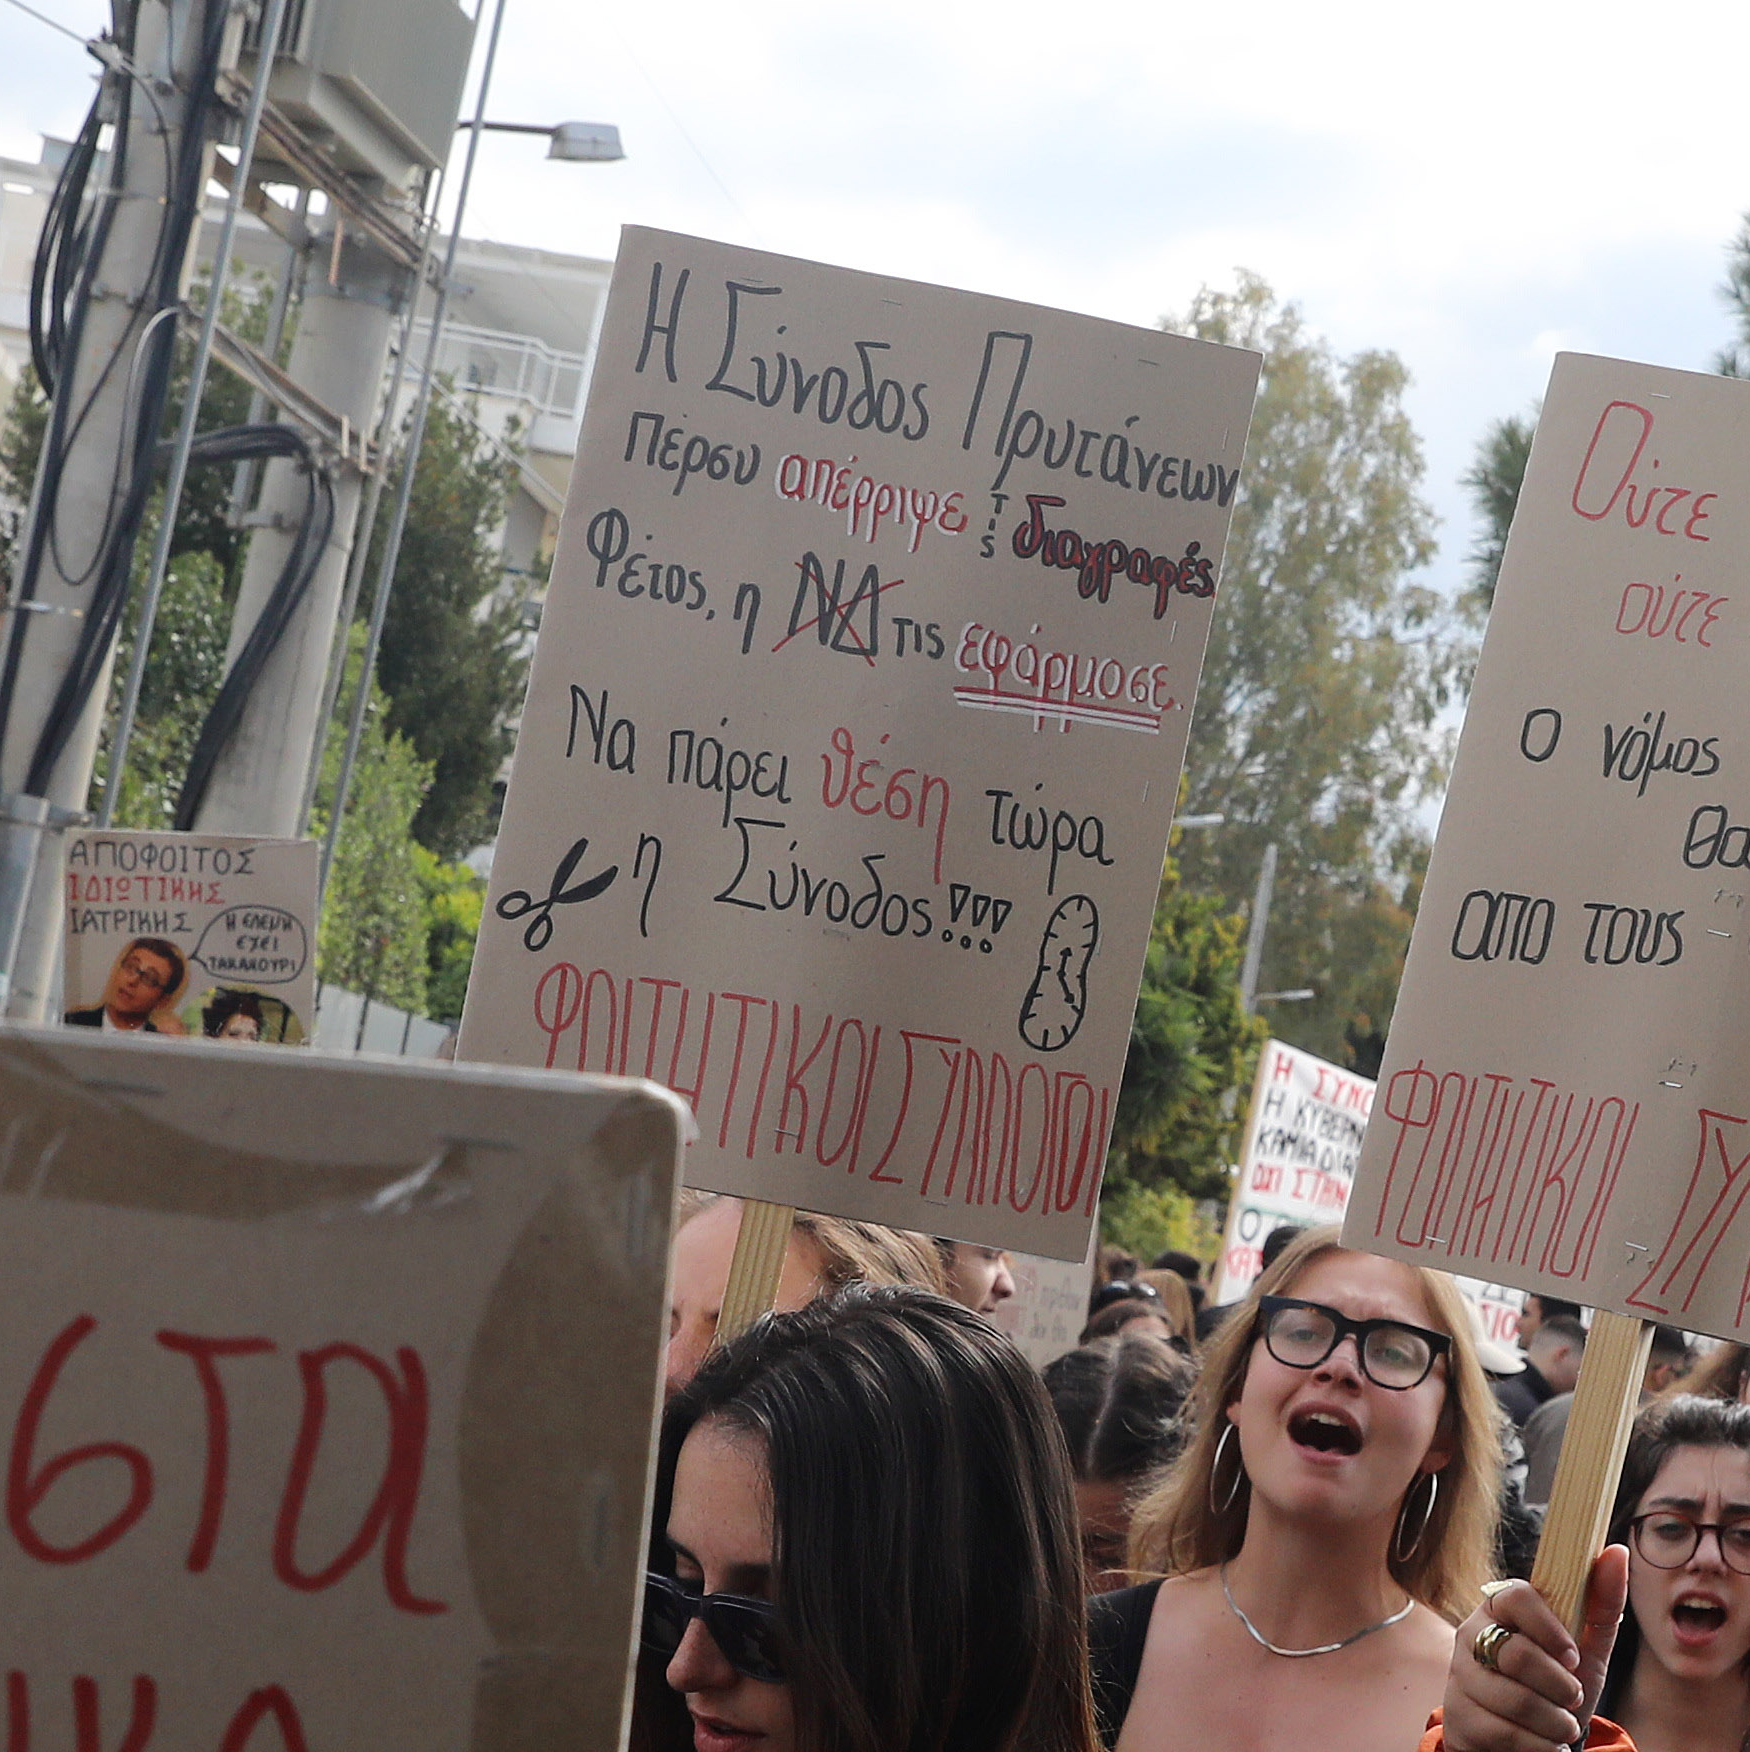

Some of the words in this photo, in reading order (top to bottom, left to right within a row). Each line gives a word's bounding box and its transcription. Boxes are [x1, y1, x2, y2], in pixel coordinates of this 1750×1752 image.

[635, 262, 690, 382] Η
[706, 281, 929, 440] Σύνοδος
[962, 331, 1240, 507] Πρυτάνεων
[624, 411, 761, 496] Πέρσυ
[775, 454, 968, 553] απέρριψε
[1012, 494, 1216, 619] διαγραφές
[1572, 400, 1717, 542] Ούτε
[587, 508, 715, 621] Φέτος,
[733, 583, 761, 655] η
[1615, 574, 1728, 647] ούτε
[565, 684, 635, 773] Να
[667, 718, 791, 826] πάρει
[821, 726, 950, 884] θέση
[986, 782, 1114, 895] τώρα
[1603, 710, 1720, 798] νόμος
[67, 873, 226, 905] ΙΔΙΩΤΙΚΗΣ
[69, 839, 256, 875] ΑΠΟΦΟΙΤΟΣ
[633, 833, 661, 937] η
[70, 907, 192, 933] ΙΑΤΡΙΚΗΣ
[1584, 903, 1685, 965] τους
[535, 961, 883, 1174] ΦΟΙΤΗΤΙΚΟΙ
[869, 1030, 1108, 1218] ΣΥΛΛΟΓΟΙ
[1264, 1088, 1285, 1117] Η
[1294, 1096, 1366, 1147] ΚΥΒΕΡΝ
[1273, 1052, 1294, 1085] Η
[1312, 1065, 1374, 1118] ΣΥΝΟ
[1375, 1058, 1641, 1283] ΦΟΙΤΗΤΙΚΟΙ
